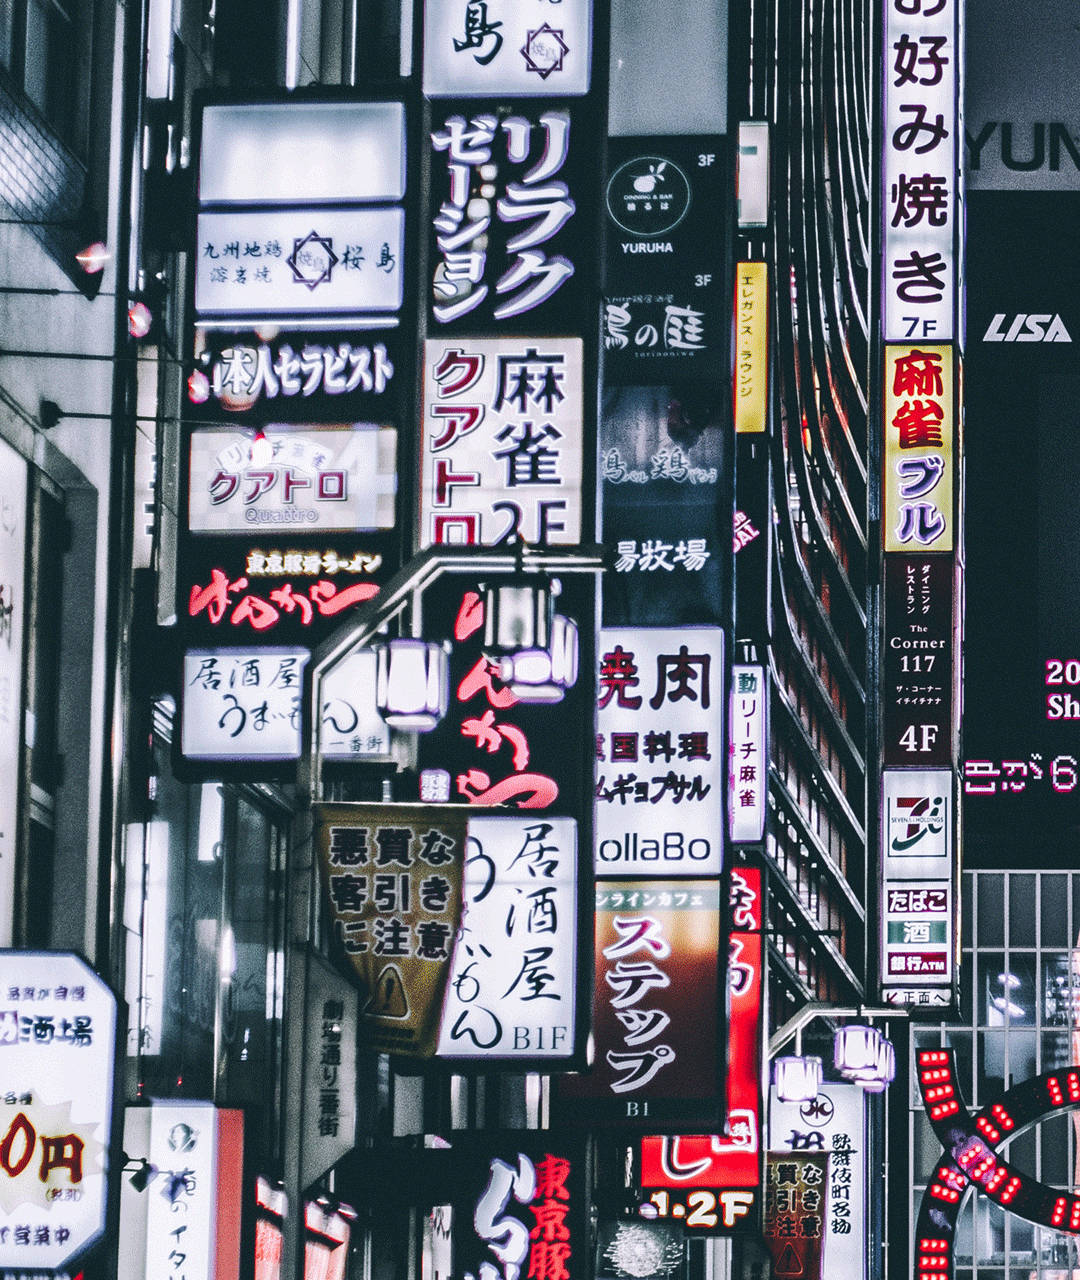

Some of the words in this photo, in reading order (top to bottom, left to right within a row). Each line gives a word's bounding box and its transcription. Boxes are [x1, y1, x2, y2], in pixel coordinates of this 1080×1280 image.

[697, 154, 716, 167] 3F
[430, 115, 498, 324] ゼーション
[493, 116, 576, 320] リラク
[342, 242, 397, 274] 桜島
[621, 242, 674, 254] YURUHA
[694, 274, 713, 287] 3F
[901, 316, 938, 338] 7F
[491, 347, 569, 487] 麻雀
[429, 348, 486, 546] クアトロ
[208, 469, 348, 505] クアトロ
[491, 499, 567, 546] 2F
[906, 565, 916, 615] レストラン
[920, 564, 931, 615] ダイニング
[890, 636, 946, 649] Corner
[909, 624, 929, 633] The
[188, 657, 300, 690] 居酒屋
[900, 655, 936, 673] 117
[895, 697, 942, 705] イチイチナナ
[738, 699, 757, 809] リーチ麻雀
[899, 724, 939, 753] 4F
[329, 825, 456, 868] 悪質な
[597, 832, 712, 862] ollaBo
[329, 873, 451, 915] 客引き
[889, 890, 947, 912] たばこ
[501, 823, 561, 1002] 居酒屋
[903, 921, 931, 944] 酒
[604, 914, 676, 1095] ステップ
[903, 992, 946, 1004] 正面へ
[512, 1026, 568, 1051] B1F
